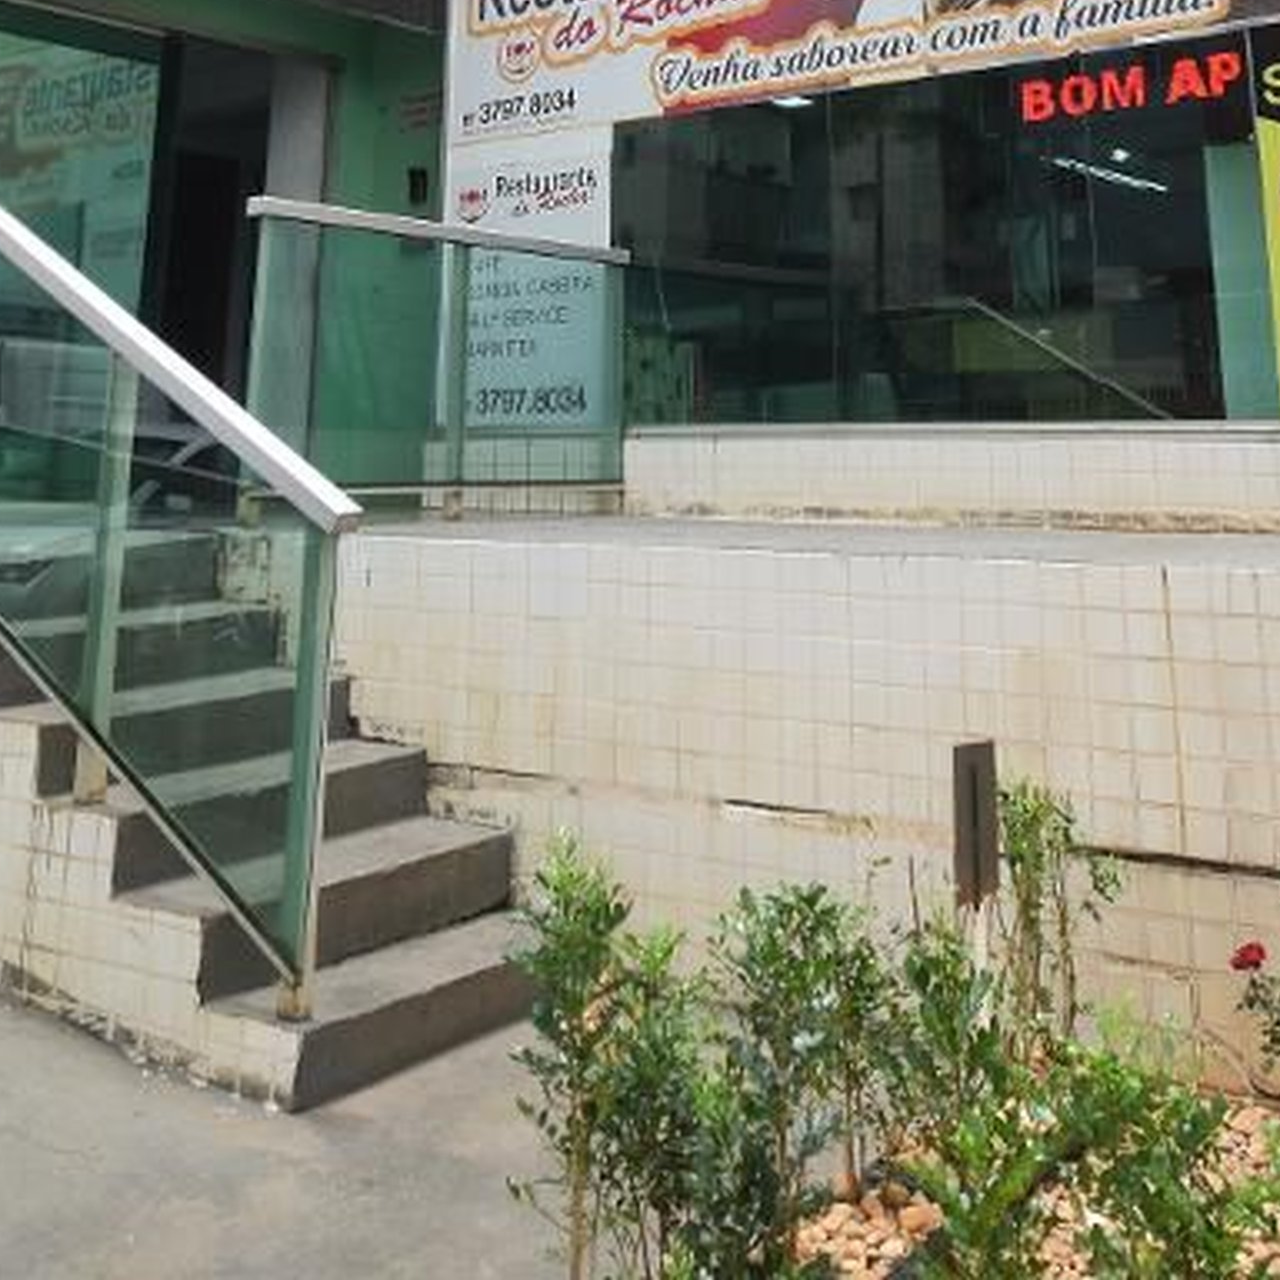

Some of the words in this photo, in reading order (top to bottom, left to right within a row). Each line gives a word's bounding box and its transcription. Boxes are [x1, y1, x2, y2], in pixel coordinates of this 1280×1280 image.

[552, 5, 599, 50] do
[659, 46, 760, 93] Venha
[769, 30, 917, 79] saborear
[930, 19, 1003, 53] com
[1018, 11, 1041, 39] a
[1021, 63, 1147, 122] BOM
[1165, 50, 1242, 106] AP
